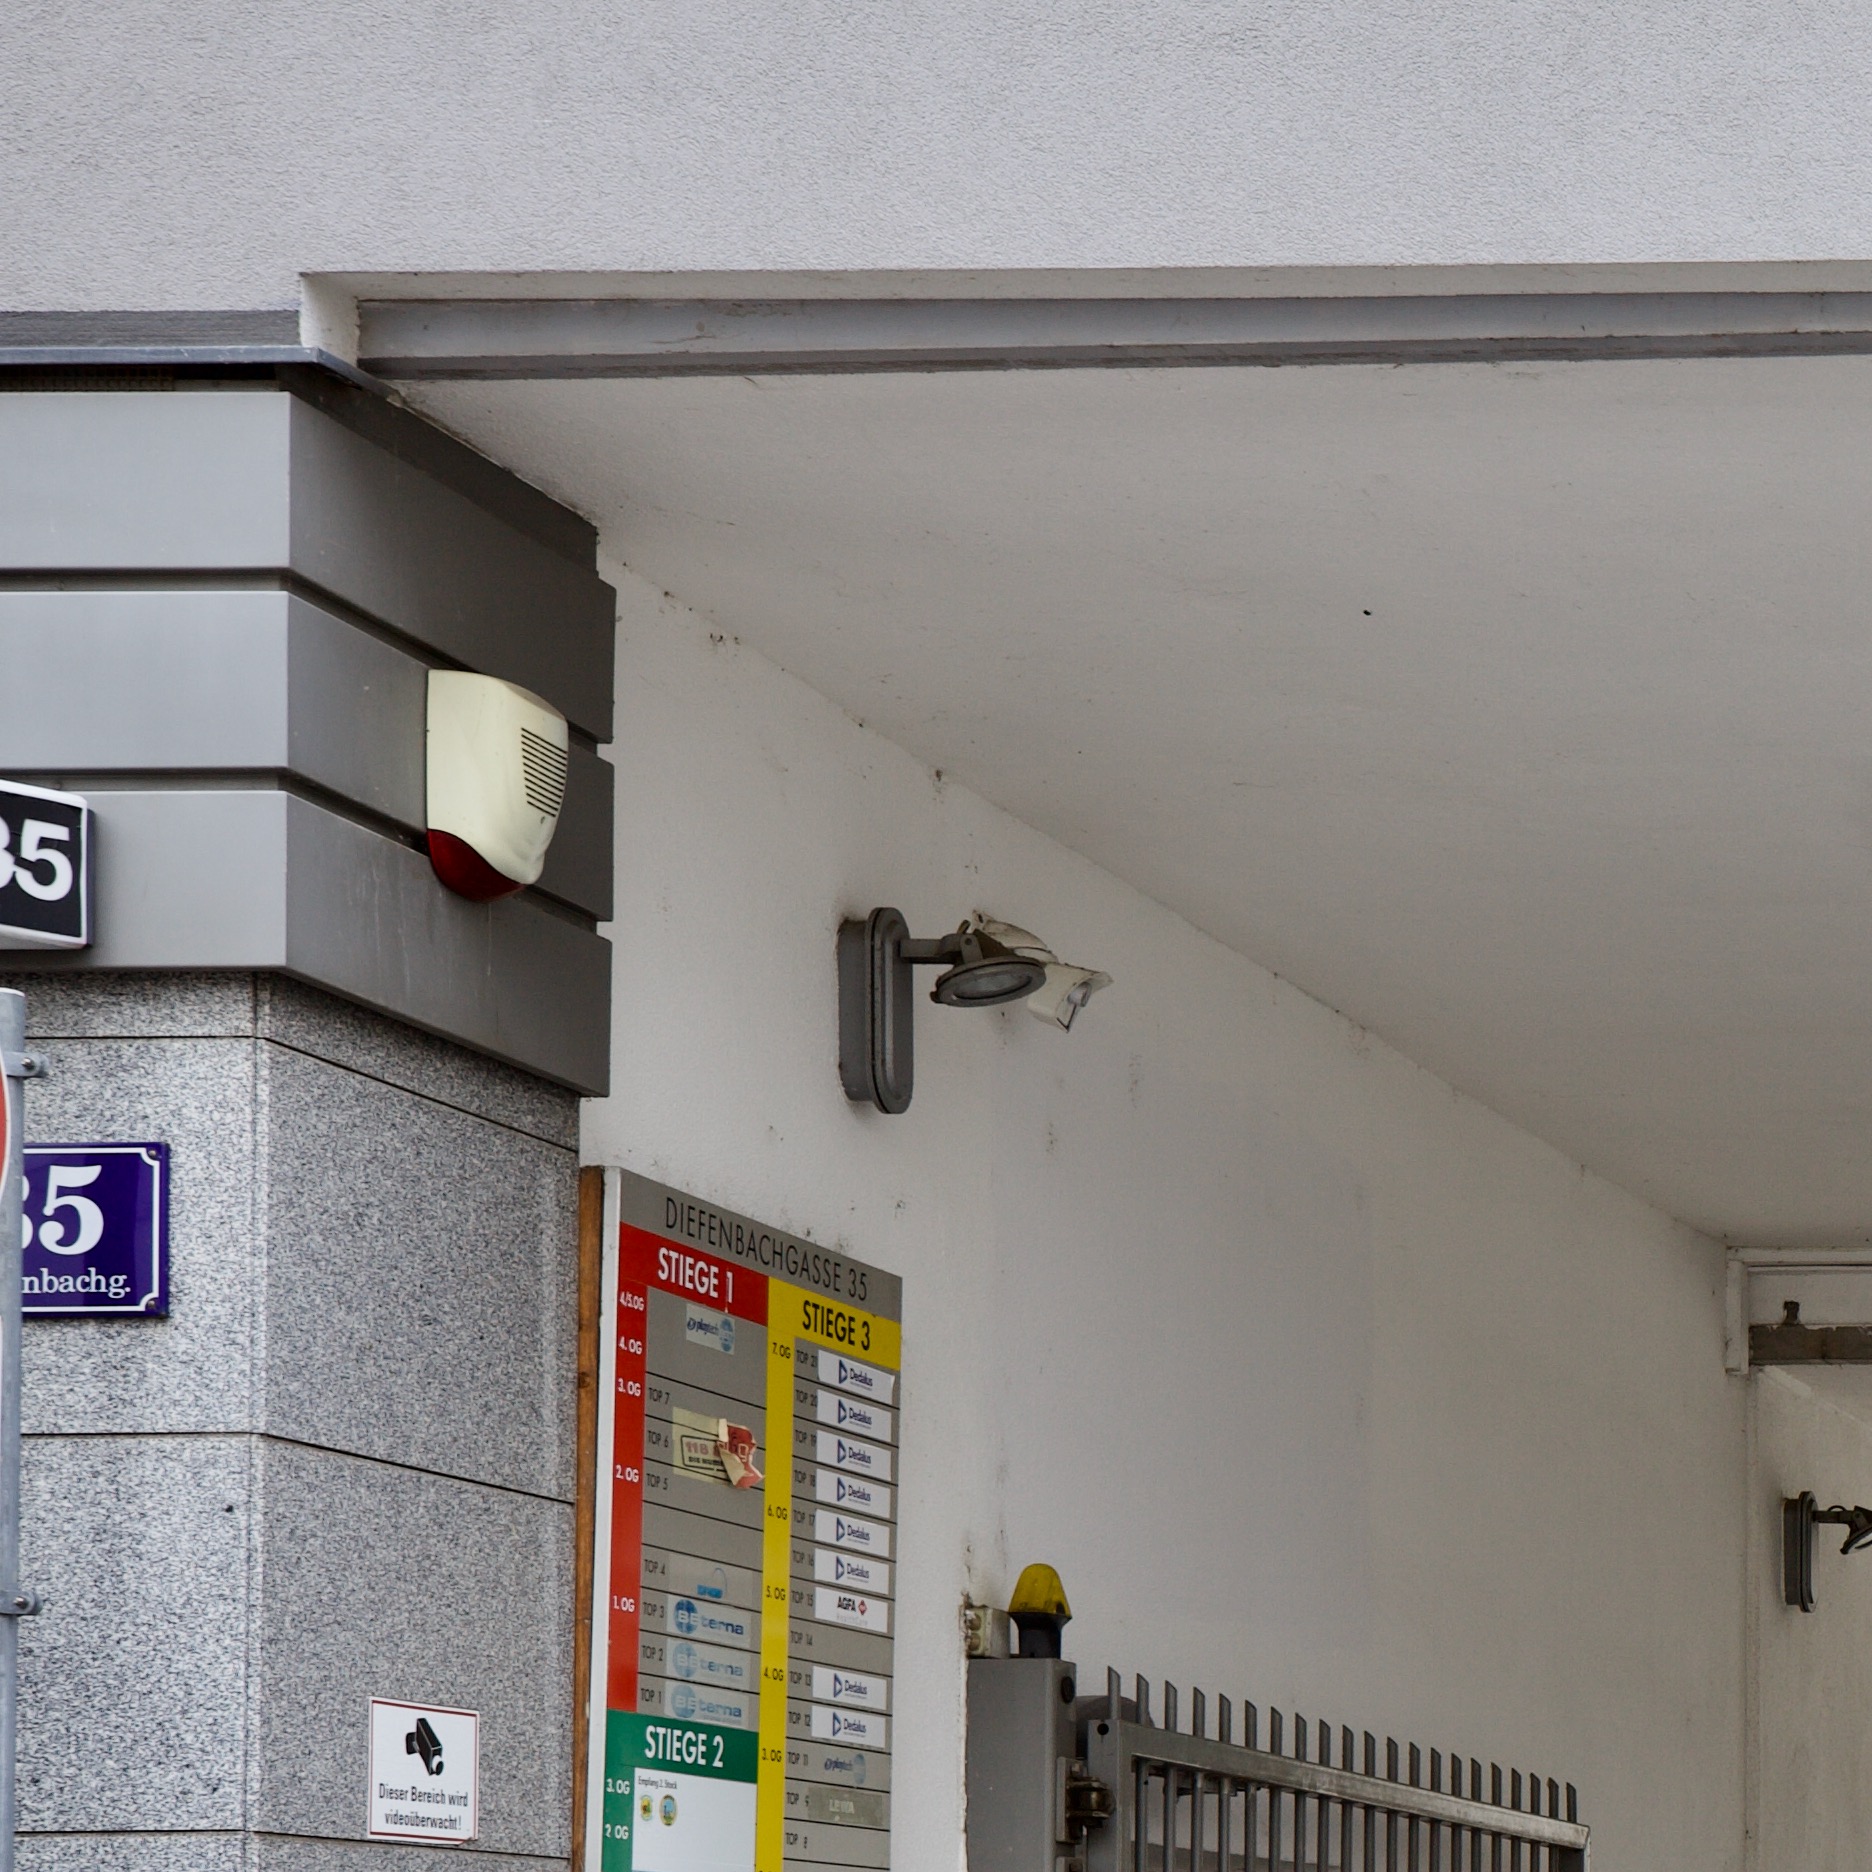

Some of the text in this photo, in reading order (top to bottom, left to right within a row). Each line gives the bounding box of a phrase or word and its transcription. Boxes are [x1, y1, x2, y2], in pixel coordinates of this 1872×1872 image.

[0, 816, 73, 901] 5
[22, 1165, 104, 1256] 5
[666, 1197, 867, 1301] DIEFENBACHGASSE 35
[658, 1247, 734, 1303] STIEGE 1
[802, 1300, 870, 1351] STIEGE 3
[850, 1368, 873, 1387] Dedalus
[648, 1387, 663, 1402] TOP
[849, 1407, 872, 1425] Dedalus
[648, 1430, 661, 1446] TOP
[848, 1447, 871, 1464] Dedalus
[646, 1473, 661, 1489] TOP
[848, 1485, 871, 1502] Dedalus
[847, 1525, 870, 1541] Dedalus
[644, 1560, 658, 1574] TOP
[846, 1563, 869, 1579] Dedalus
[643, 1602, 657, 1616] TOP
[837, 1596, 856, 1612] AGFA
[642, 1645, 656, 1659] TOP
[640, 1688, 654, 1702] TOP
[845, 1680, 868, 1695] Dedalus
[843, 1718, 867, 1733] Dedalus
[644, 1725, 724, 1768] STIEGE 2
[379, 1783, 468, 1807] Dieser Bereich wird
[385, 1809, 462, 1831] videoüberwacht!
